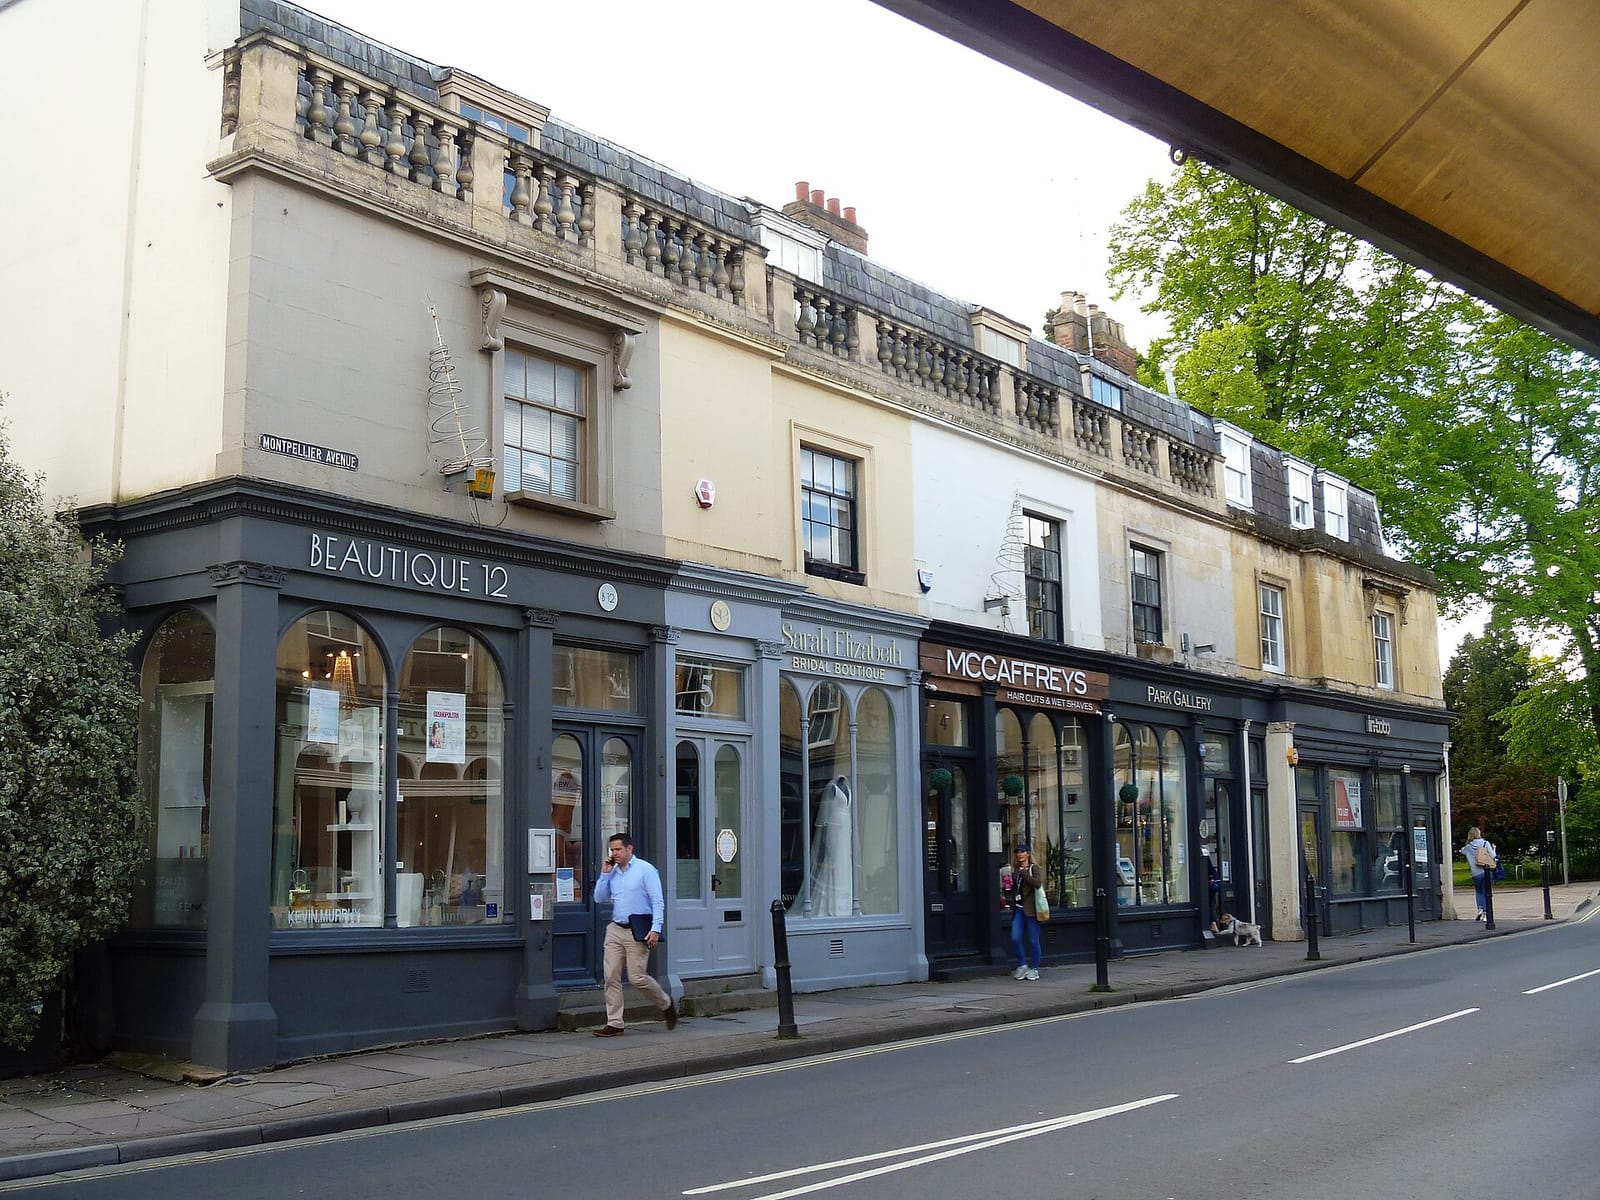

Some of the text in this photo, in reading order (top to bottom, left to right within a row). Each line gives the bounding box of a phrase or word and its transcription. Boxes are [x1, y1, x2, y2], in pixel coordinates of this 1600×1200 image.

[262, 435, 357, 468] MONTPELLIER AVENUE
[310, 533, 508, 598] BEAUTIQUE 12
[781, 622, 903, 665] Sarah Elizabeth
[792, 656, 886, 680] BRIDAL BOUTIQUE
[946, 649, 1088, 695] MCCAFFREYS
[700, 673, 714, 708] 5
[1007, 691, 1094, 711] HAIR CUTS & WET SHAVES
[1147, 685, 1212, 711] PARK GALLERY
